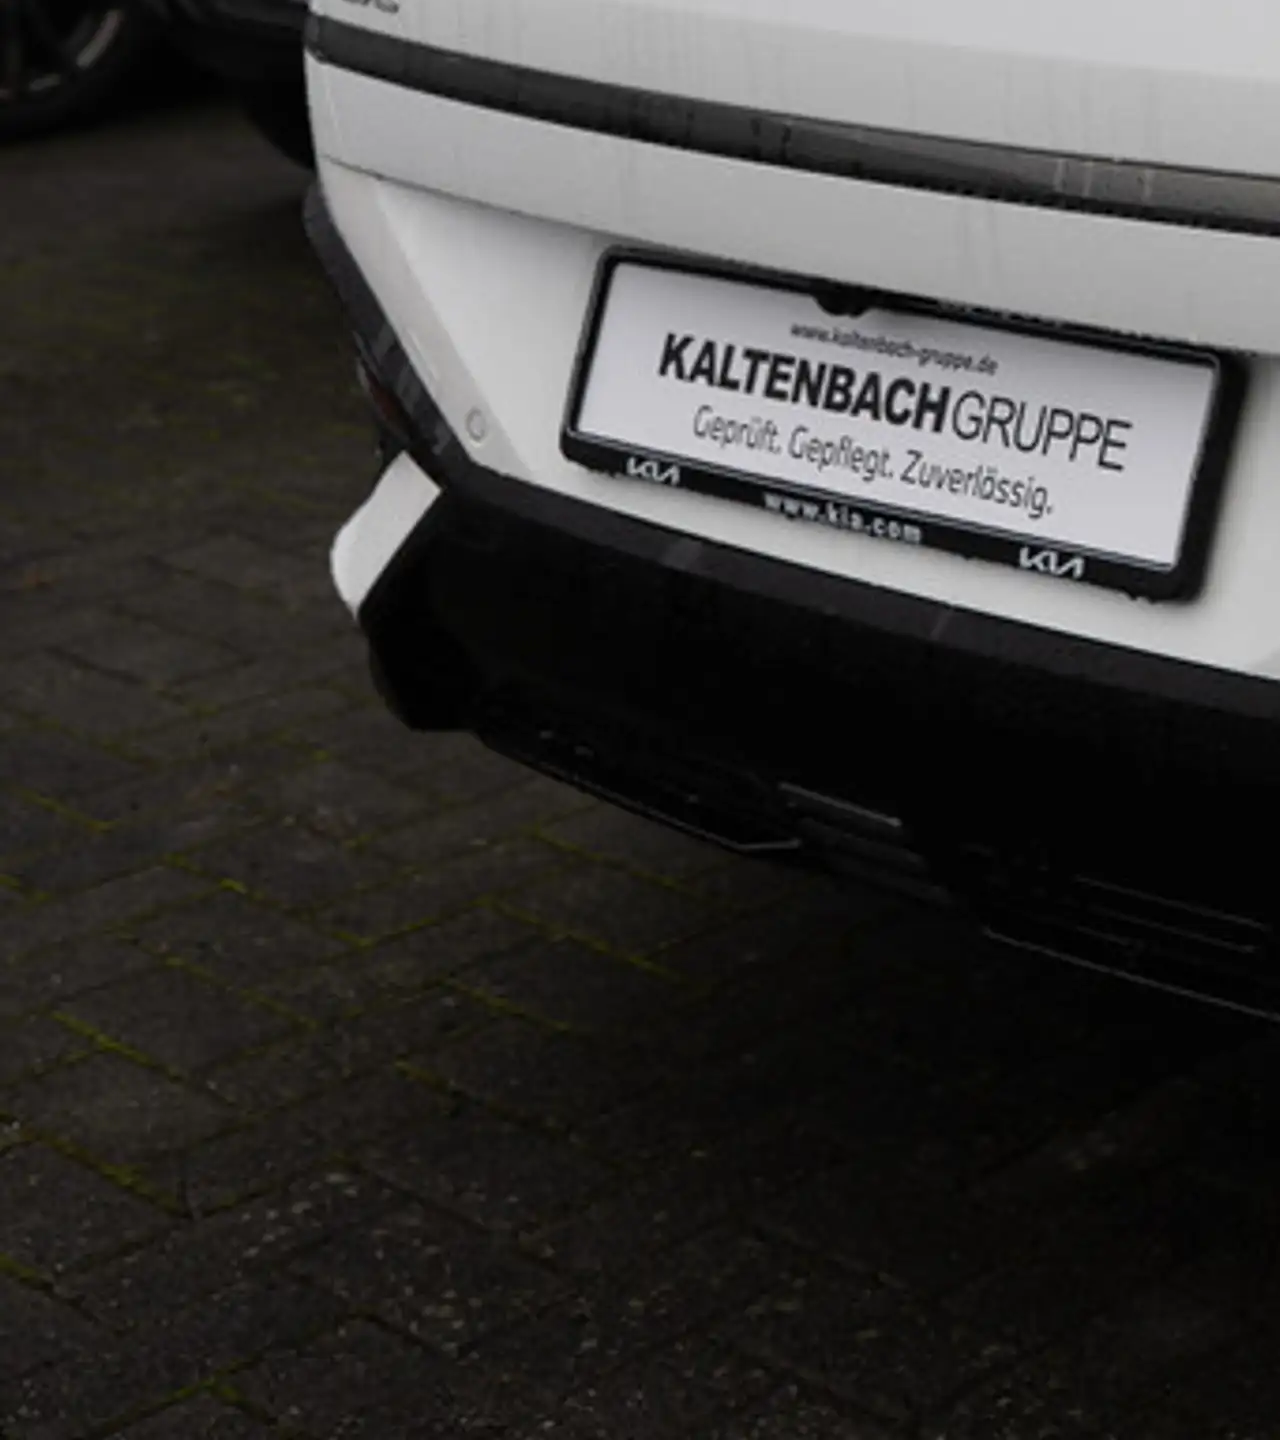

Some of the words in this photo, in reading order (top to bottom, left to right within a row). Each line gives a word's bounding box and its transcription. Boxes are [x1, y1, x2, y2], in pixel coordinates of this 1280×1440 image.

[626, 456, 681, 486] KIA
[693, 404, 782, 455] Geprüft.
[787, 424, 894, 483] Gepflegt.
[900, 449, 1054, 520] Zuverlässig.
[763, 491, 922, 545] www.kia.com
[1019, 546, 1085, 579] KIA
